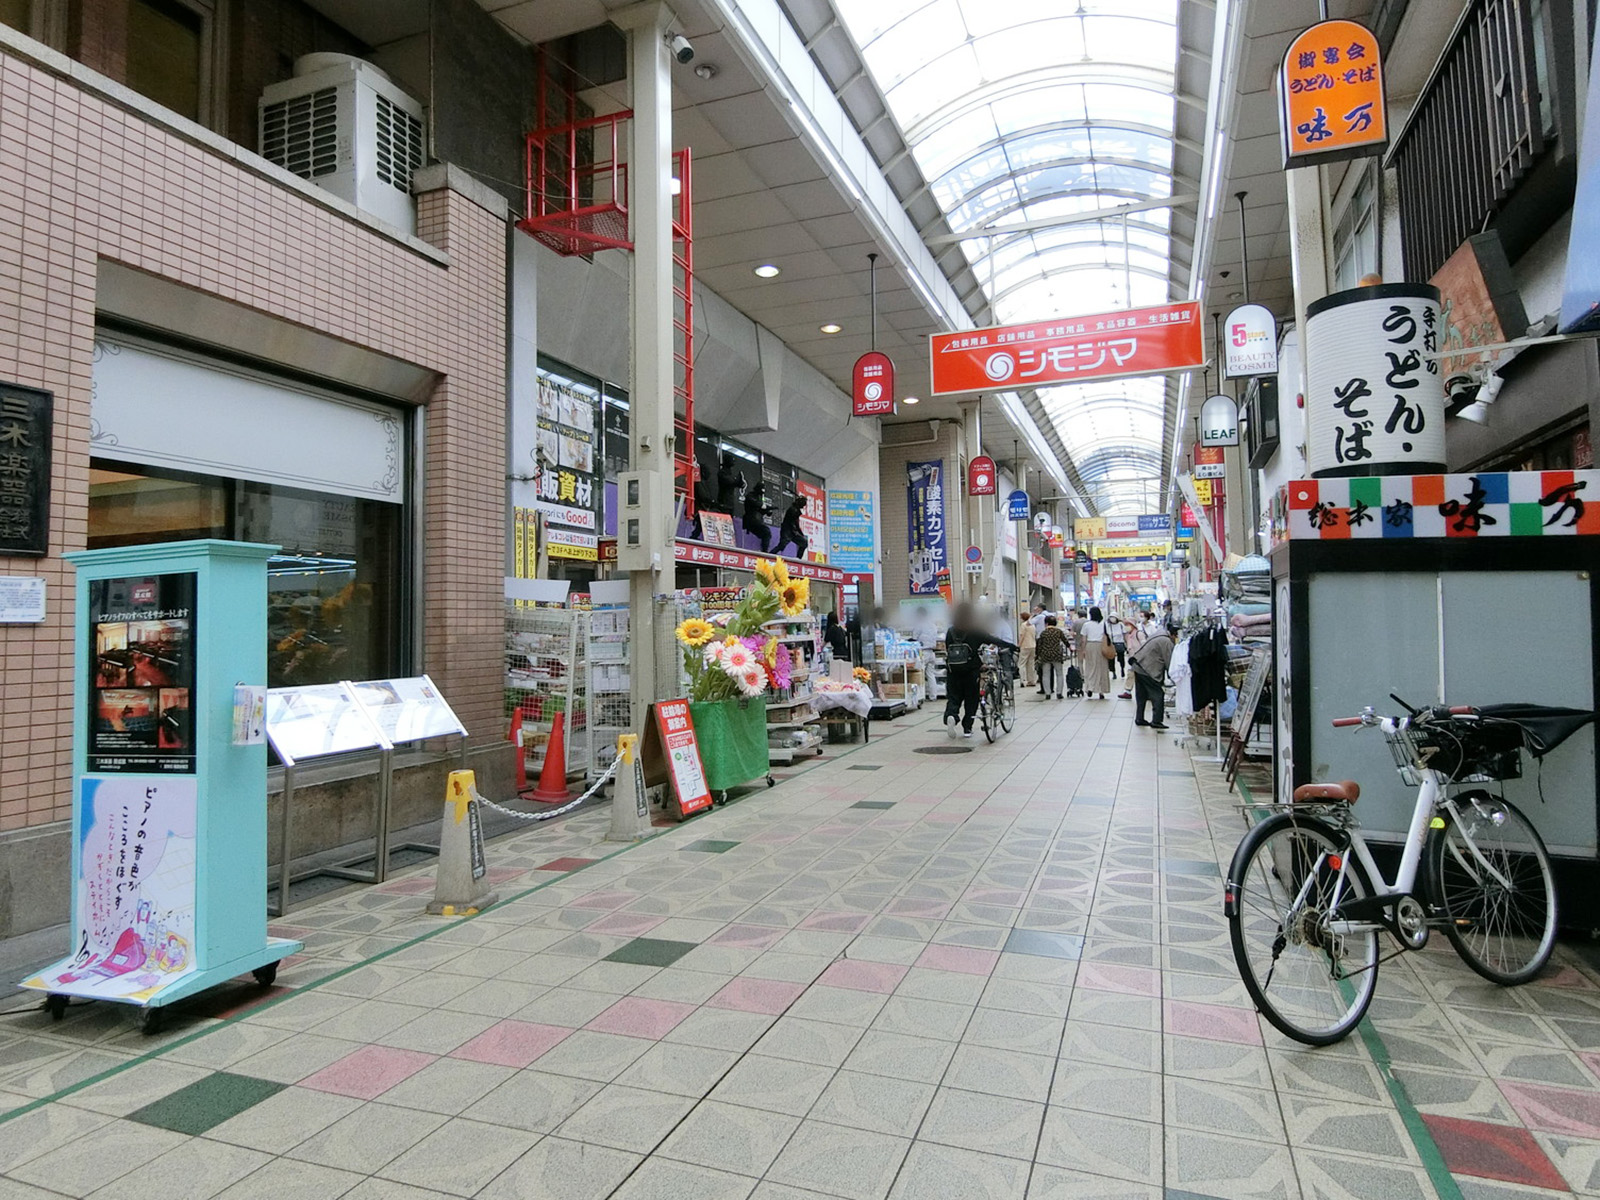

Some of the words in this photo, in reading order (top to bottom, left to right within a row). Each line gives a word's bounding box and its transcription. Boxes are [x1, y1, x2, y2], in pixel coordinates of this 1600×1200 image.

[1297, 102, 1373, 142] 味万
[951, 336, 988, 349] 包装用品
[997, 329, 1036, 343] 店舗用品
[1045, 324, 1085, 337] 事務用品
[1096, 317, 1137, 331] 食品容器
[1148, 310, 1191, 324] 生活雑貨
[1019, 338, 1137, 377] シモジマ
[1229, 361, 1276, 372] COSME
[1230, 352, 1276, 363] BEAUTY
[857, 401, 890, 412] シモジマ
[1333, 378, 1374, 463] そば
[0, 396, 32, 505] 三木楽器
[1204, 428, 1236, 440] LEAF
[1108, 520, 1137, 528] docomo
[1438, 477, 1588, 531] 味万
[926, 485, 944, 577] 酸素カプセル
[98, 608, 189, 622] ピアノライフのすべてをサポートします
[115, 806, 128, 910] こころをほぐす
[128, 786, 157, 892] ピアノの音色が
[106, 813, 115, 918] こんなときだからこそ
[90, 880, 100, 937] ステイホーム
